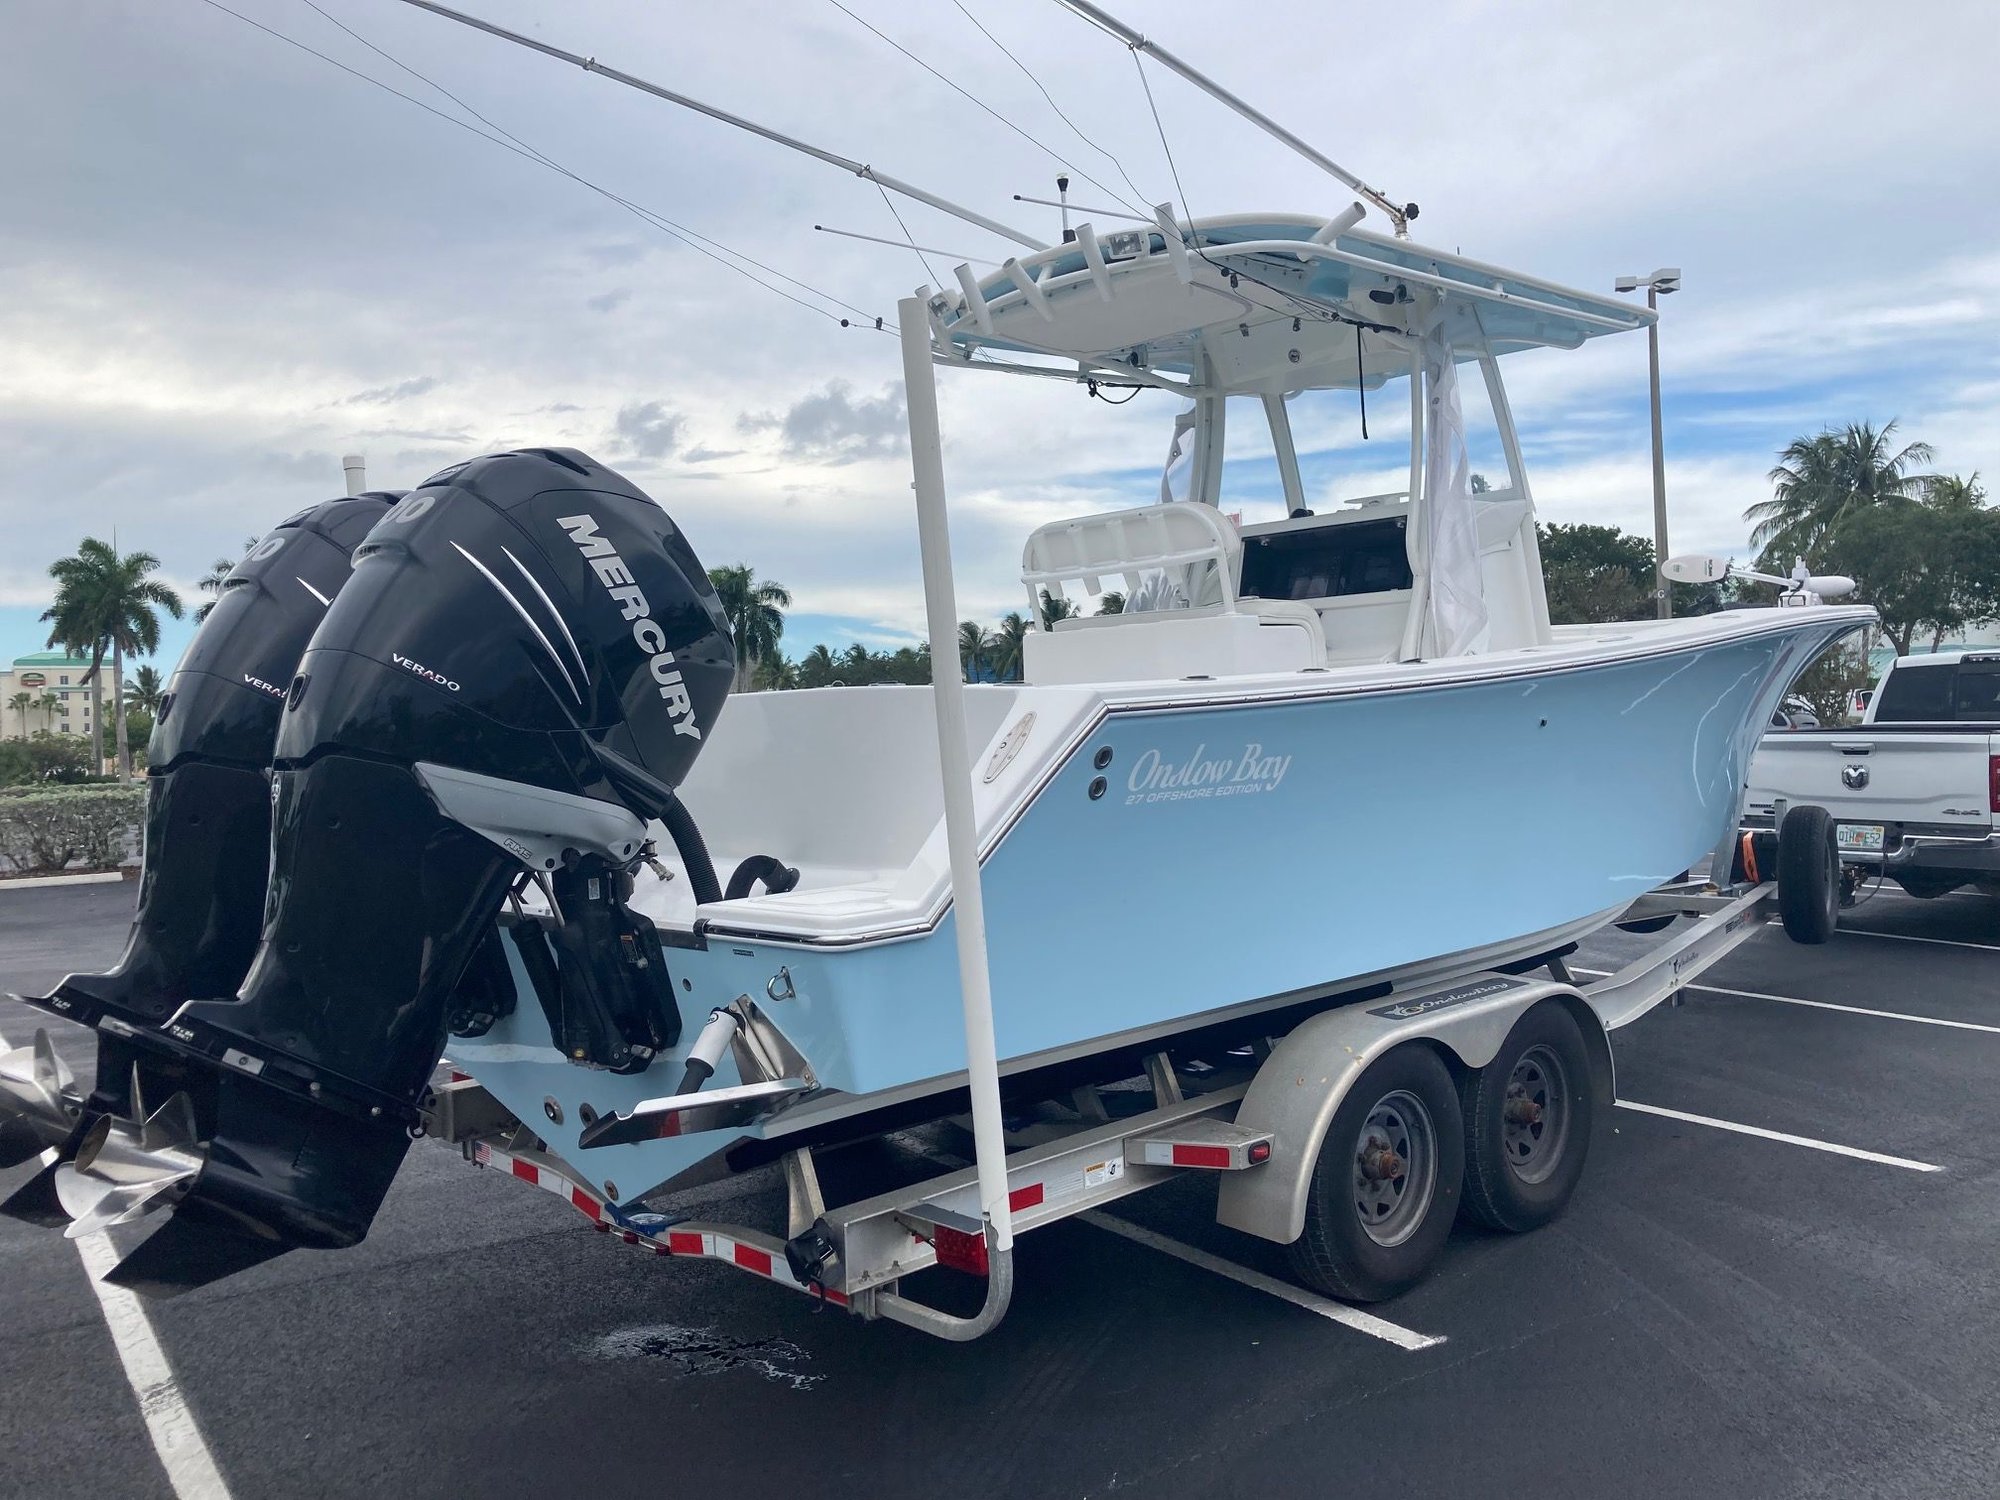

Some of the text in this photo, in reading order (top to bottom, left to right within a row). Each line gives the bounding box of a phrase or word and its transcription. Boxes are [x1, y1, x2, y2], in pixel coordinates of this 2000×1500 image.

[556, 514, 701, 740] MERCURY
[392, 652, 461, 692] VERADO
[1127, 743, 1292, 792] Onslow Bay
[1146, 787, 1215, 803] OFFSHORE
[1215, 783, 1263, 797] EDITION
